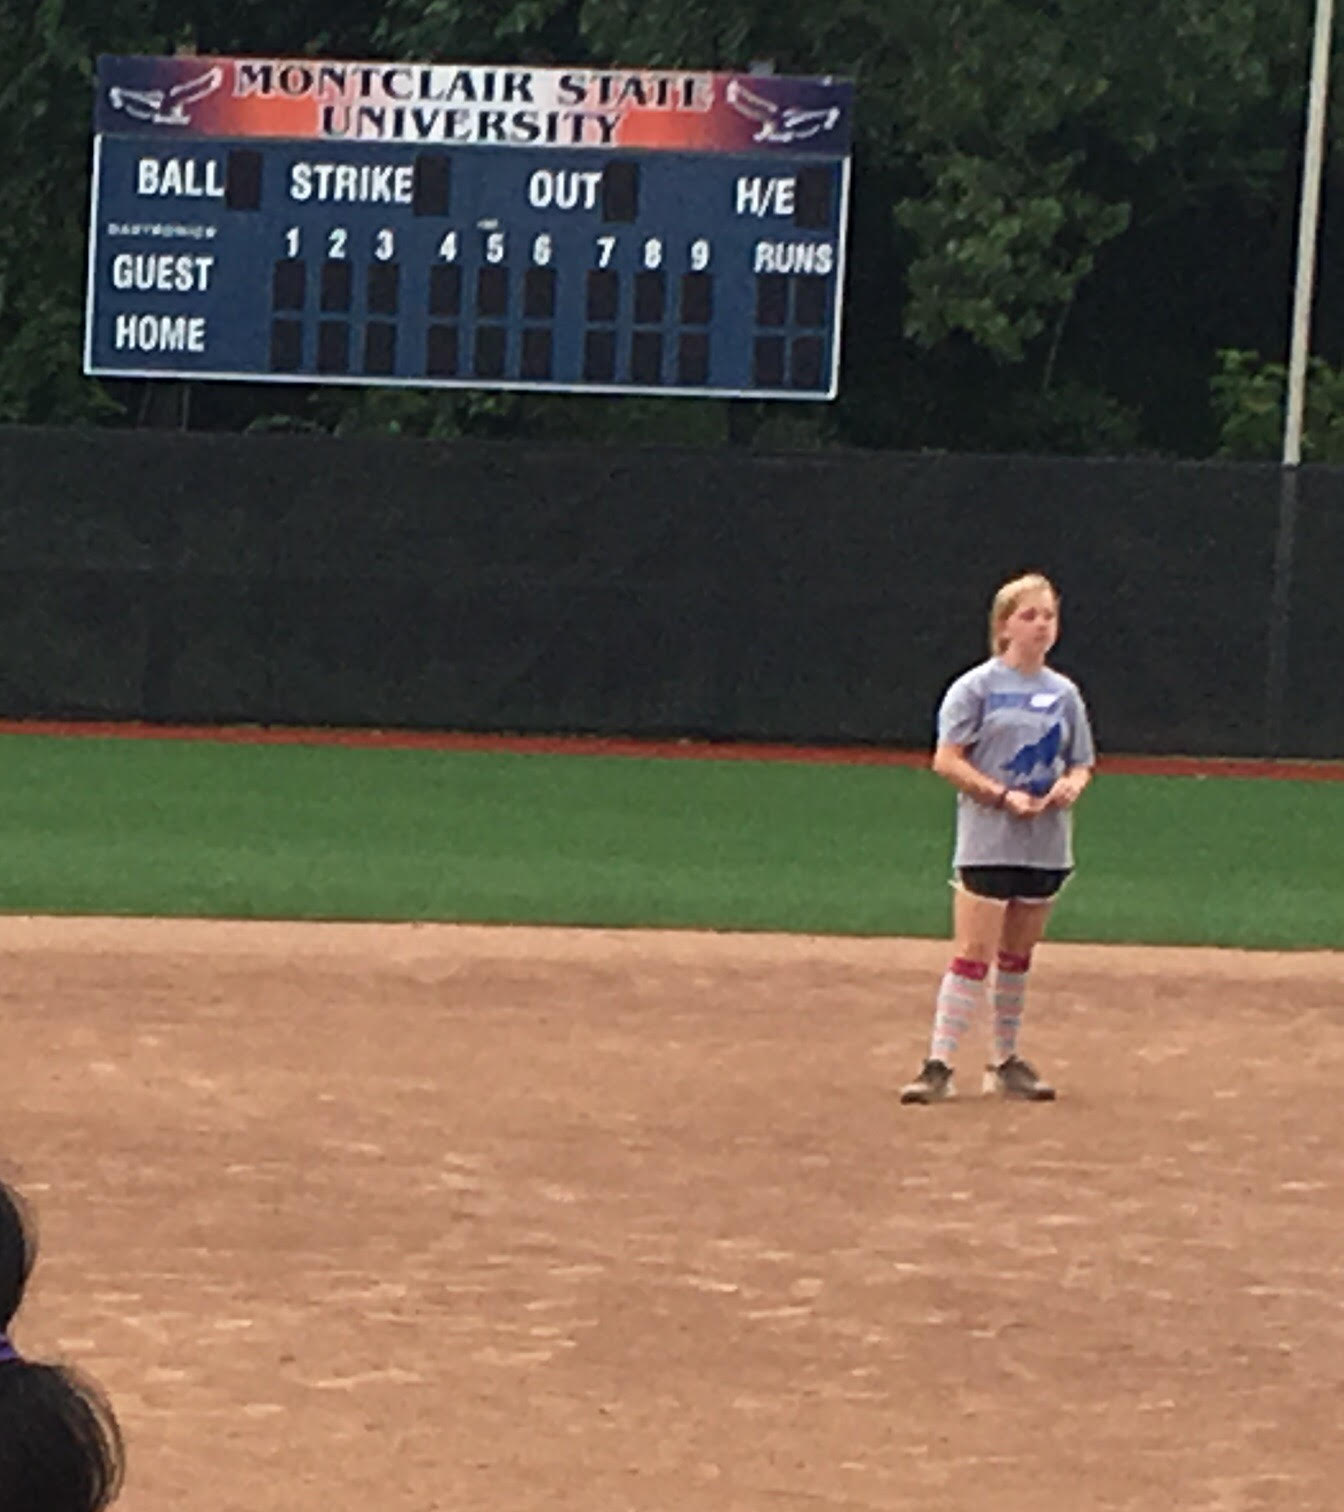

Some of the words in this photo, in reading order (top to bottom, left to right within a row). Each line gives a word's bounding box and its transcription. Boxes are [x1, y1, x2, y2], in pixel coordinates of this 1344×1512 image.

[240, 64, 534, 102] MONTCLAIR
[558, 73, 709, 110] STATE
[322, 104, 621, 143] UNIVERSITY
[138, 158, 226, 198] BALL
[290, 163, 414, 204] STRIKE
[528, 170, 603, 210] OUT
[735, 176, 797, 217] H/E
[286, 227, 300, 257] 1
[328, 228, 348, 259] 2
[375, 229, 394, 260] 3
[440, 231, 458, 262] 4
[486, 233, 504, 263] 5
[533, 234, 552, 265] 6
[596, 236, 616, 268] 7
[644, 238, 662, 269] 8
[691, 239, 710, 271] 9
[754, 241, 834, 275] RUNS
[112, 253, 214, 292] GUEST
[115, 314, 206, 352] HOME
